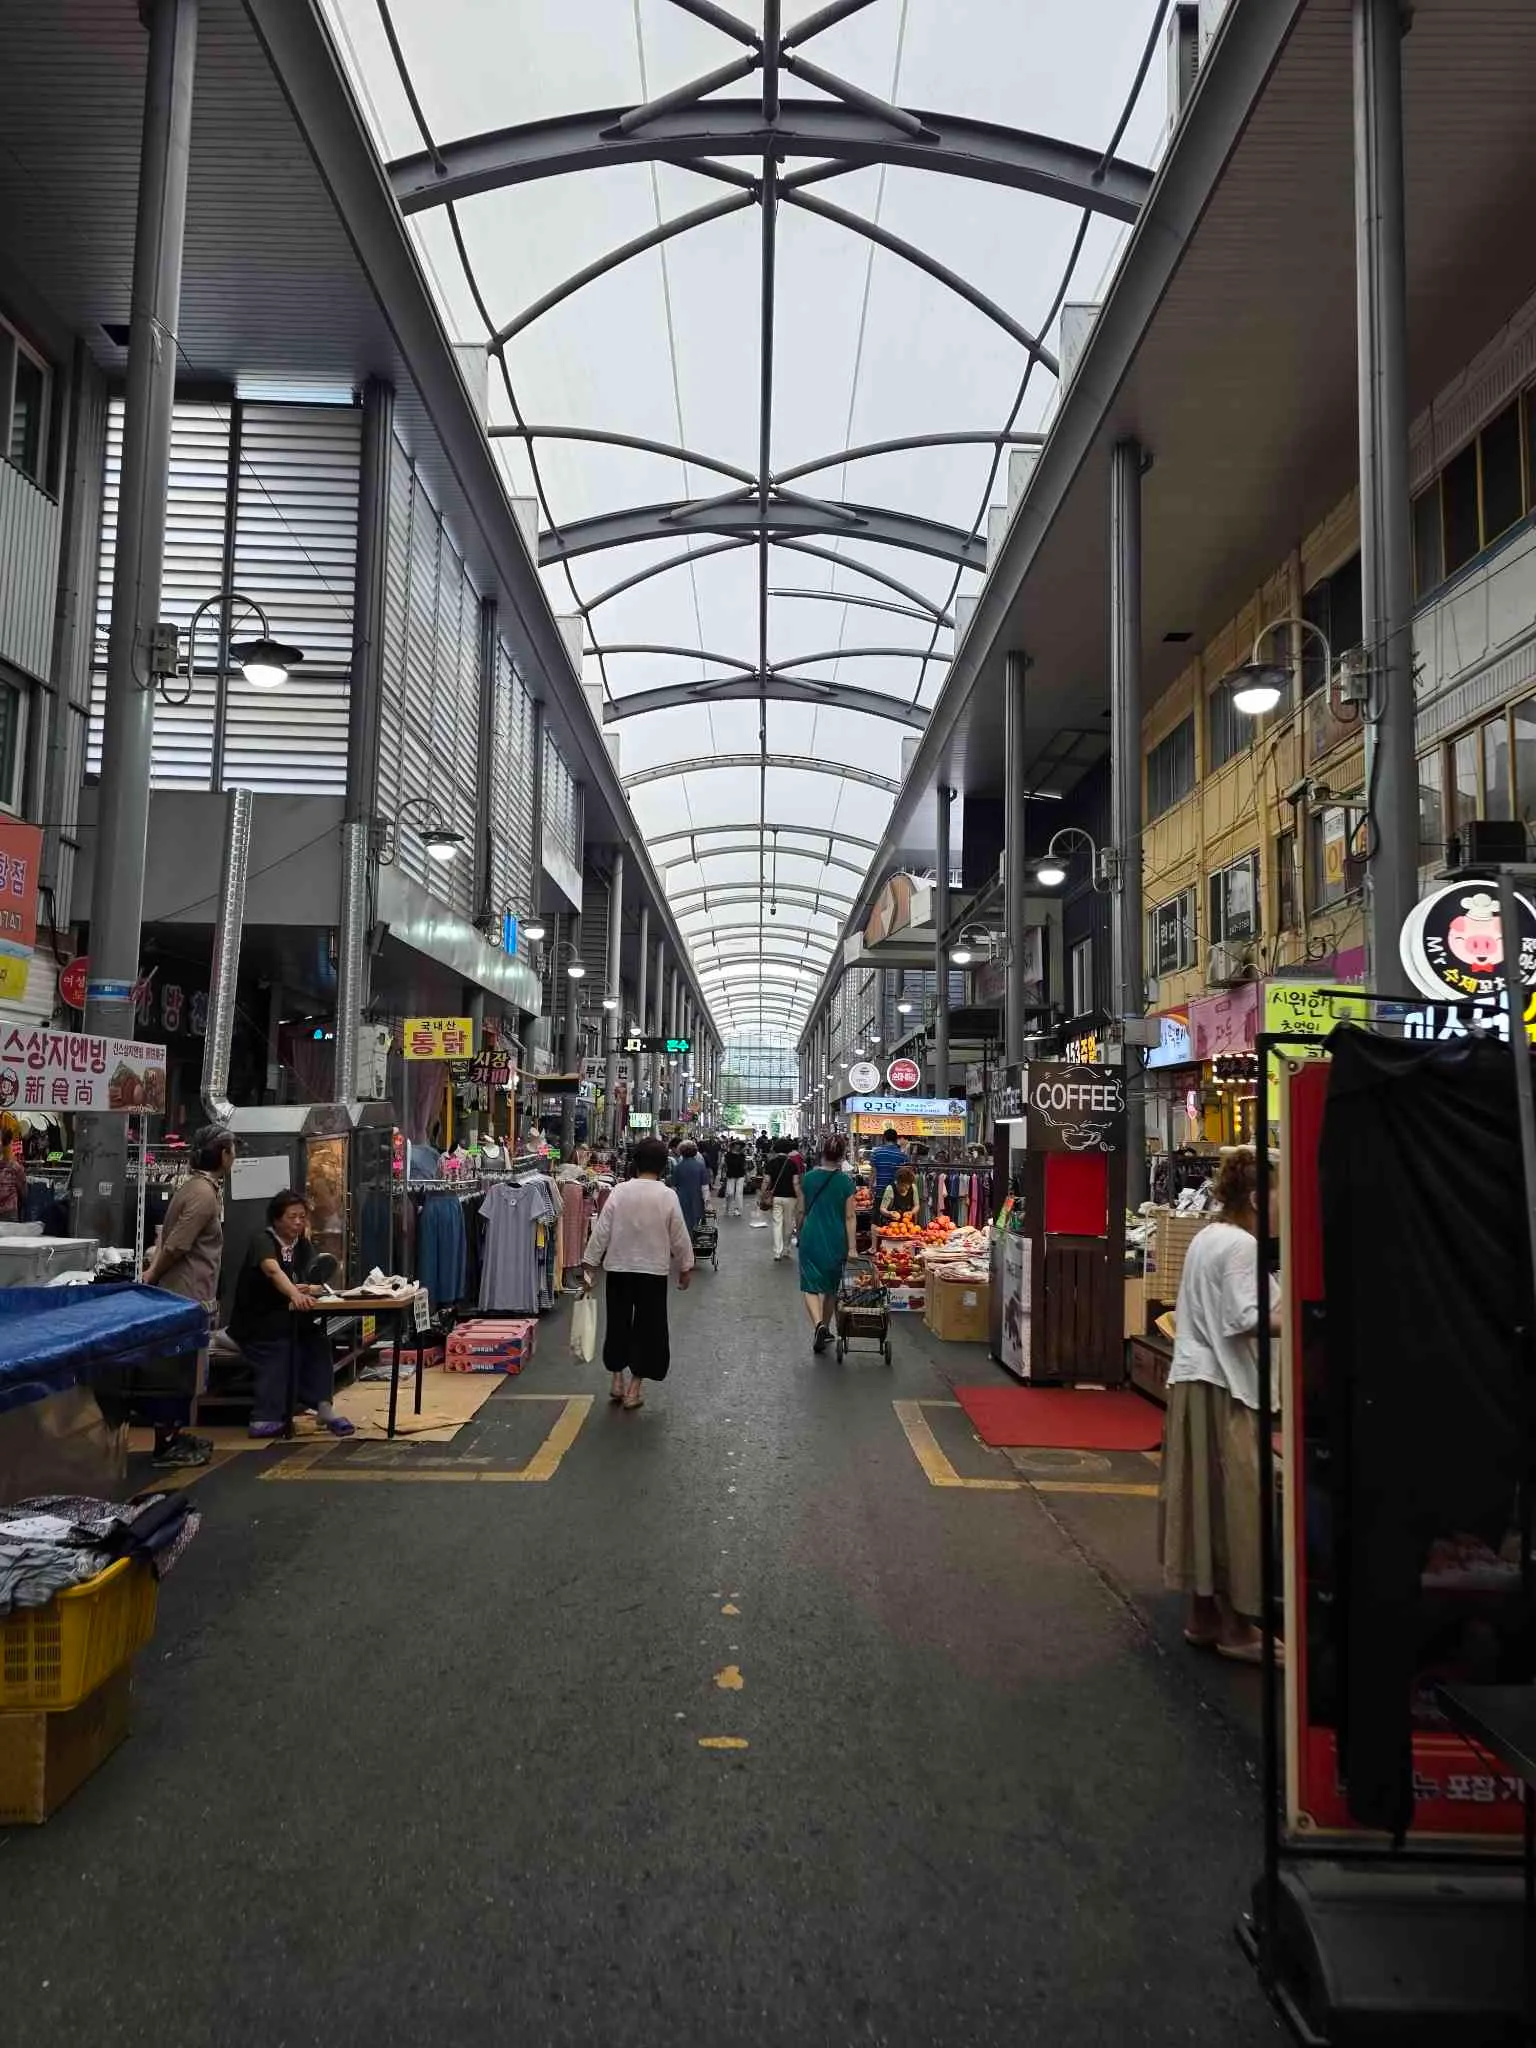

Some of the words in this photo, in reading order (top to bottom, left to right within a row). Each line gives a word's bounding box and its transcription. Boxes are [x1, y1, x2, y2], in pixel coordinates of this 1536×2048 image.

[420, 1021, 457, 1031] 국내산
[0, 1027, 107, 1075] 스상지엔빙
[24, 1074, 94, 1106] 新食尚
[1035, 1082, 1117, 1112] COFFEE
